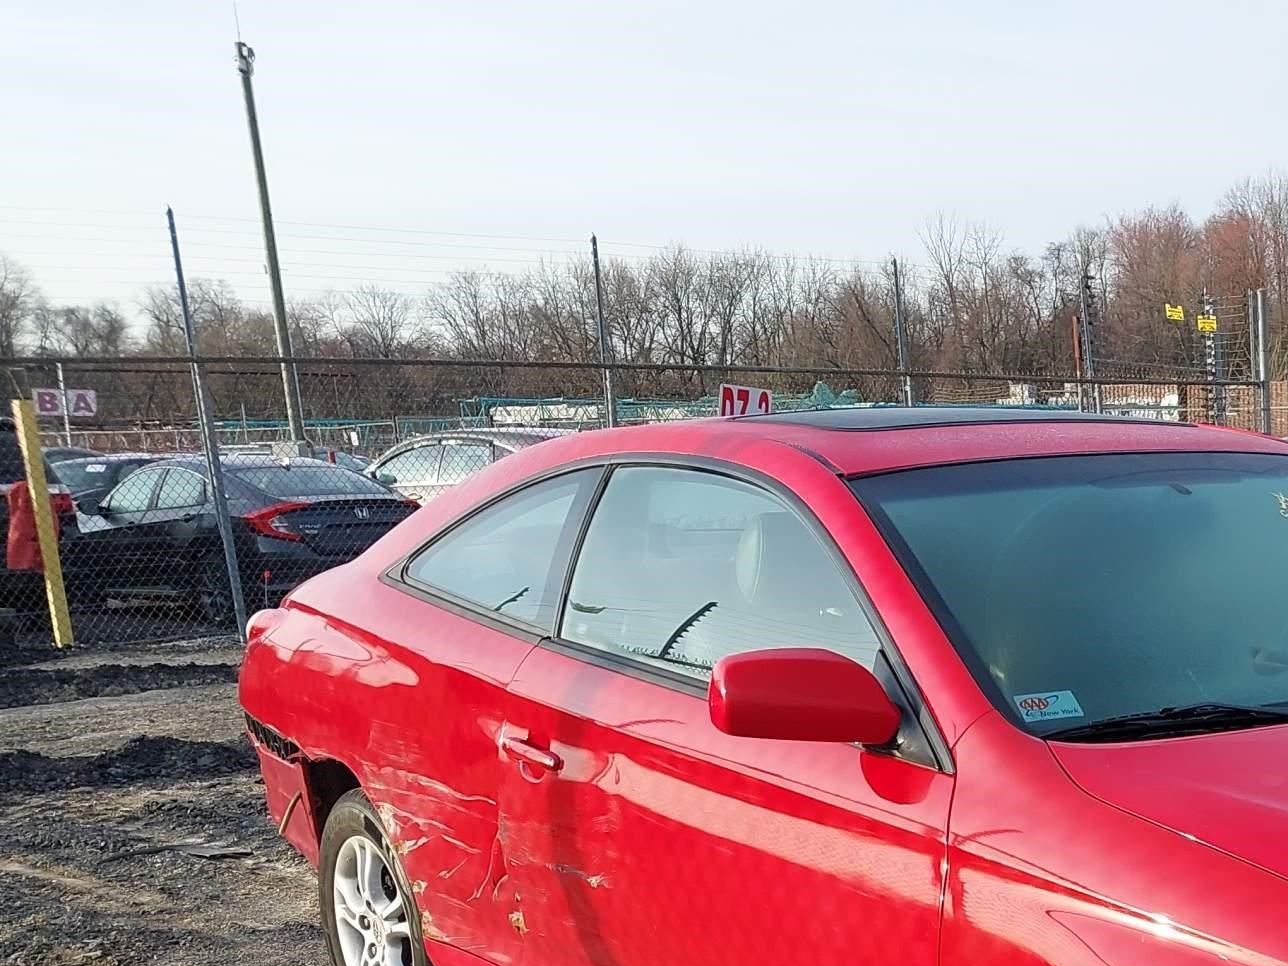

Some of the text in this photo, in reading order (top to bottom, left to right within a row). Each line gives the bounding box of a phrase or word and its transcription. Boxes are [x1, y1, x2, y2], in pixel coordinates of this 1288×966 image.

[38, 392, 94, 413] B A
[1021, 697, 1049, 710] AAA
